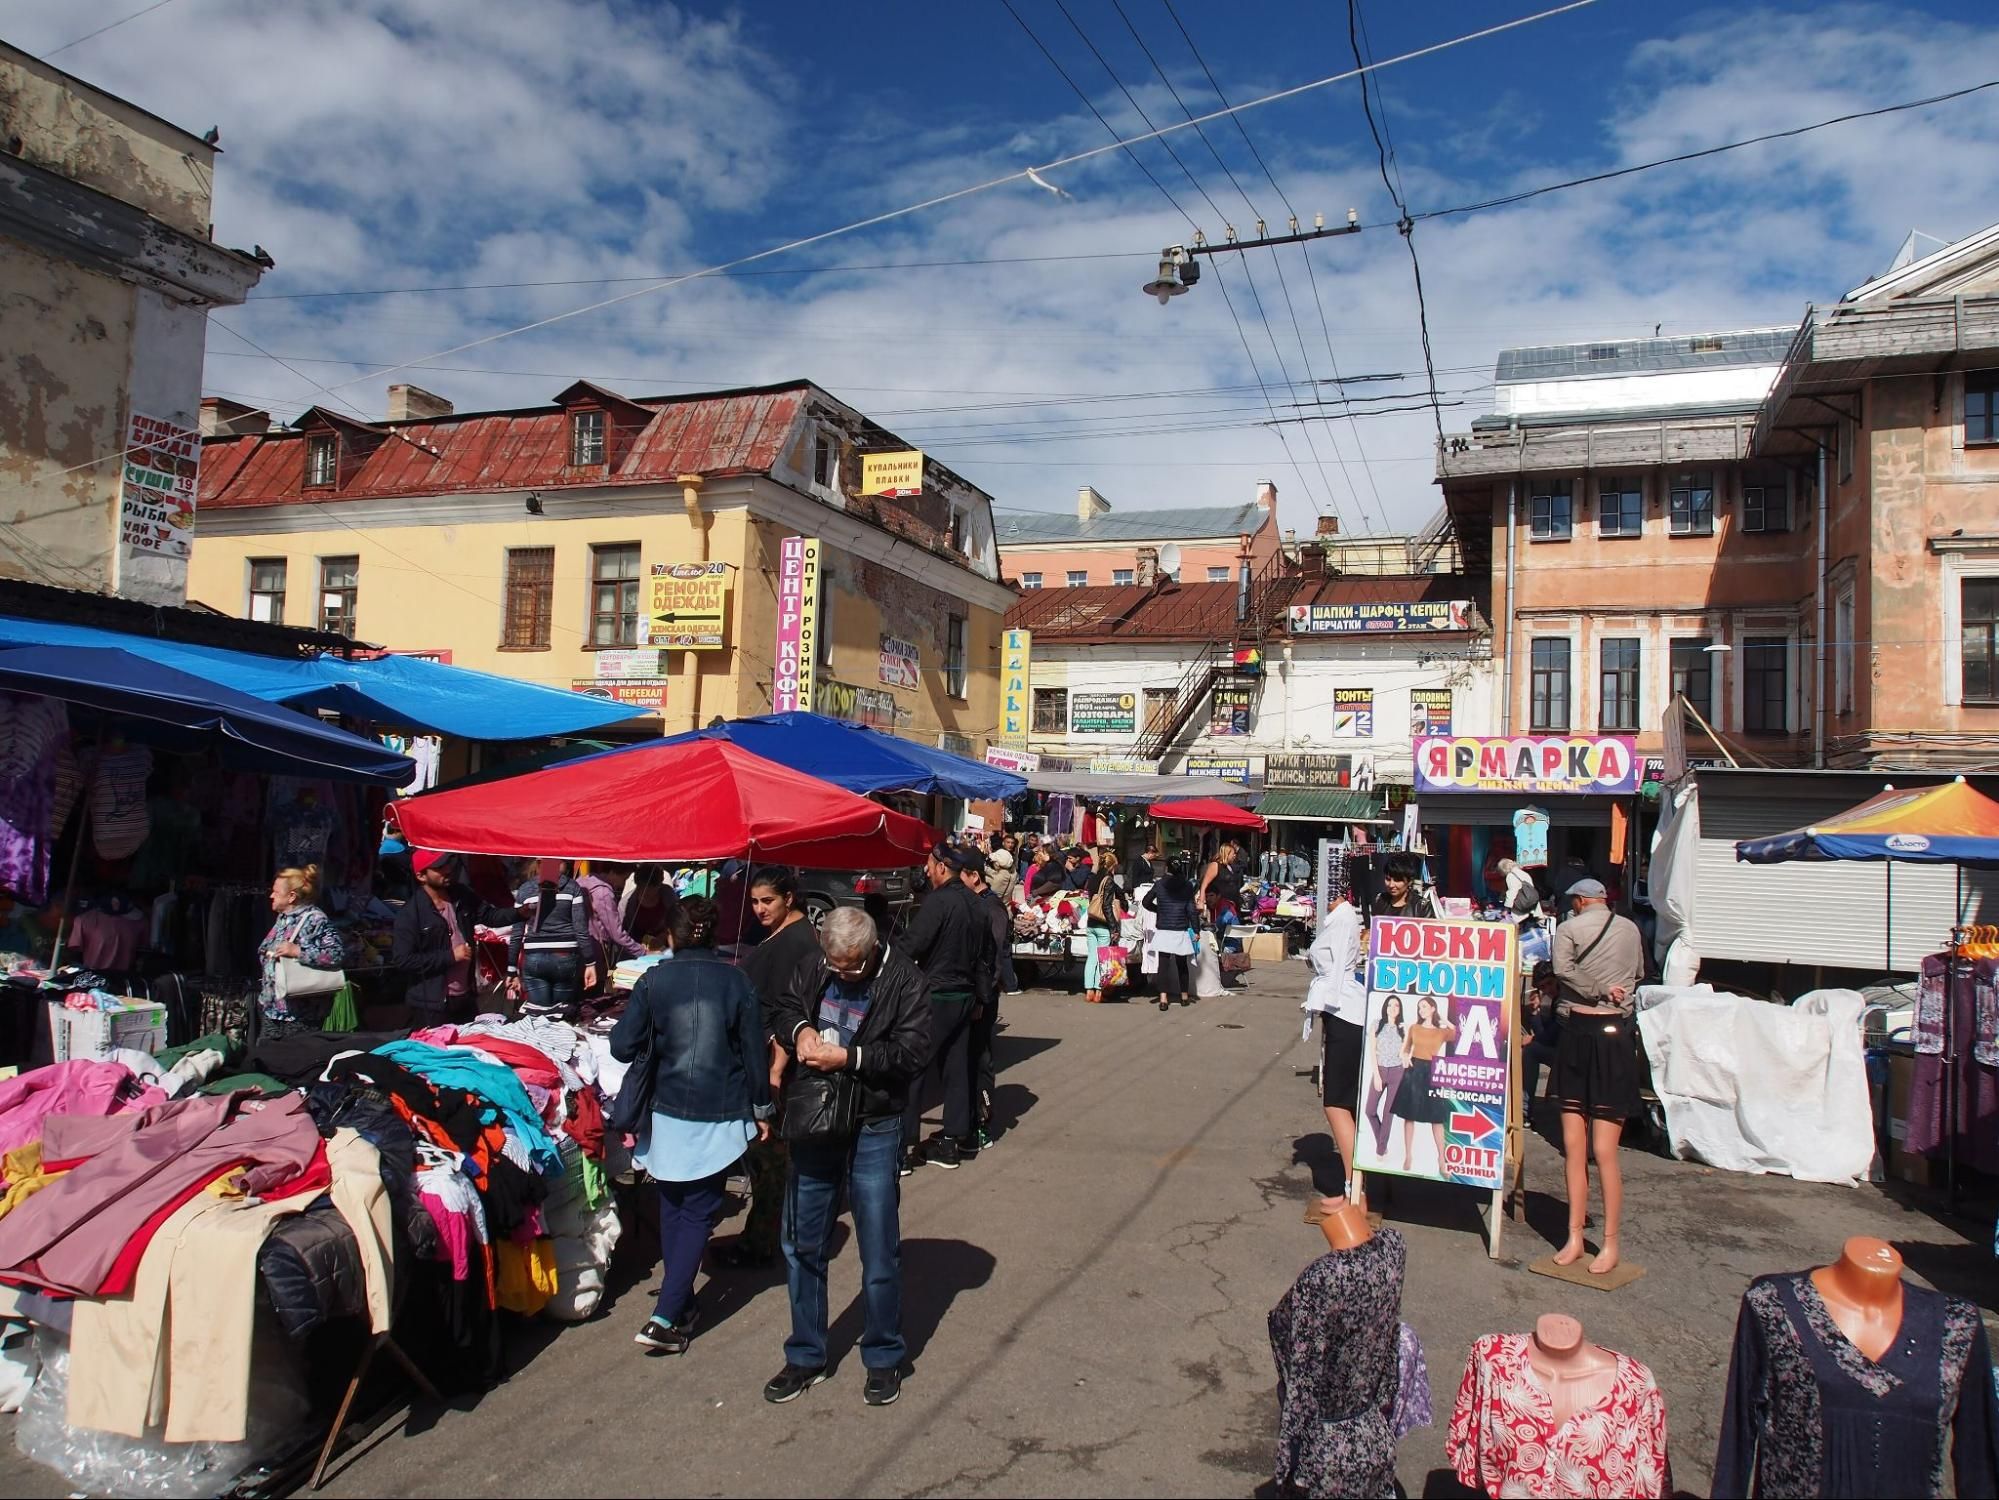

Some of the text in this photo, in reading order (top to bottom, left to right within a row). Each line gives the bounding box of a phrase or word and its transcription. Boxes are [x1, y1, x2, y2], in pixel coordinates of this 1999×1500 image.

[868, 461, 918, 472] КУПАЛЬНИКИ
[125, 463, 174, 491] СУШИ
[179, 477, 193, 490] 19
[876, 475, 910, 484] ПЛАВКИ
[123, 501, 167, 523] РЫБА
[123, 521, 149, 535] ЧАЙ
[122, 533, 162, 550] КОФЕ
[708, 562, 724, 574] 20
[654, 581, 721, 595] РЕМОНТ
[653, 596, 720, 611] ОДЕЖДЫ
[1313, 603, 1449, 619] ШАПКИ ШАРФЫ КЕПКИ
[651, 625, 721, 634] ЖЕНСКАЯ ОДЕЖДА
[776, 542, 802, 711] ЦЕНТР КОФТ
[799, 548, 816, 706] ОПТ И РОЗНИЦА
[1312, 619, 1361, 630] ПЕРЧАТКИ
[1397, 618, 1407, 629] 2
[620, 688, 662, 698] ПЕРЕЕХАЛ
[1335, 690, 1372, 702] ЗОНТЫ
[1412, 692, 1451, 702] ГОЛОВНЫЕ
[1073, 711, 1134, 719] ХОЗТОВАРЫ
[1235, 710, 1247, 723] 2
[1357, 711, 1371, 725] 2
[1430, 725, 1439, 735] 2
[1268, 754, 1337, 768] КУРТКИ ПАЛЬТО
[1429, 746, 1621, 779] ЯРМАРКА
[1189, 768, 1220, 776] НИЖНЕЕ
[1268, 768, 1339, 784] ДЖИНСЫ БРЮКИ
[1379, 922, 1506, 962] ЮБКИ
[1375, 959, 1505, 998] БРЮКИ
[1432, 1075, 1505, 1090] мануфактура
[1445, 1146, 1498, 1169] ОПТ
[1446, 1164, 1497, 1179] РОЗНИЦА
